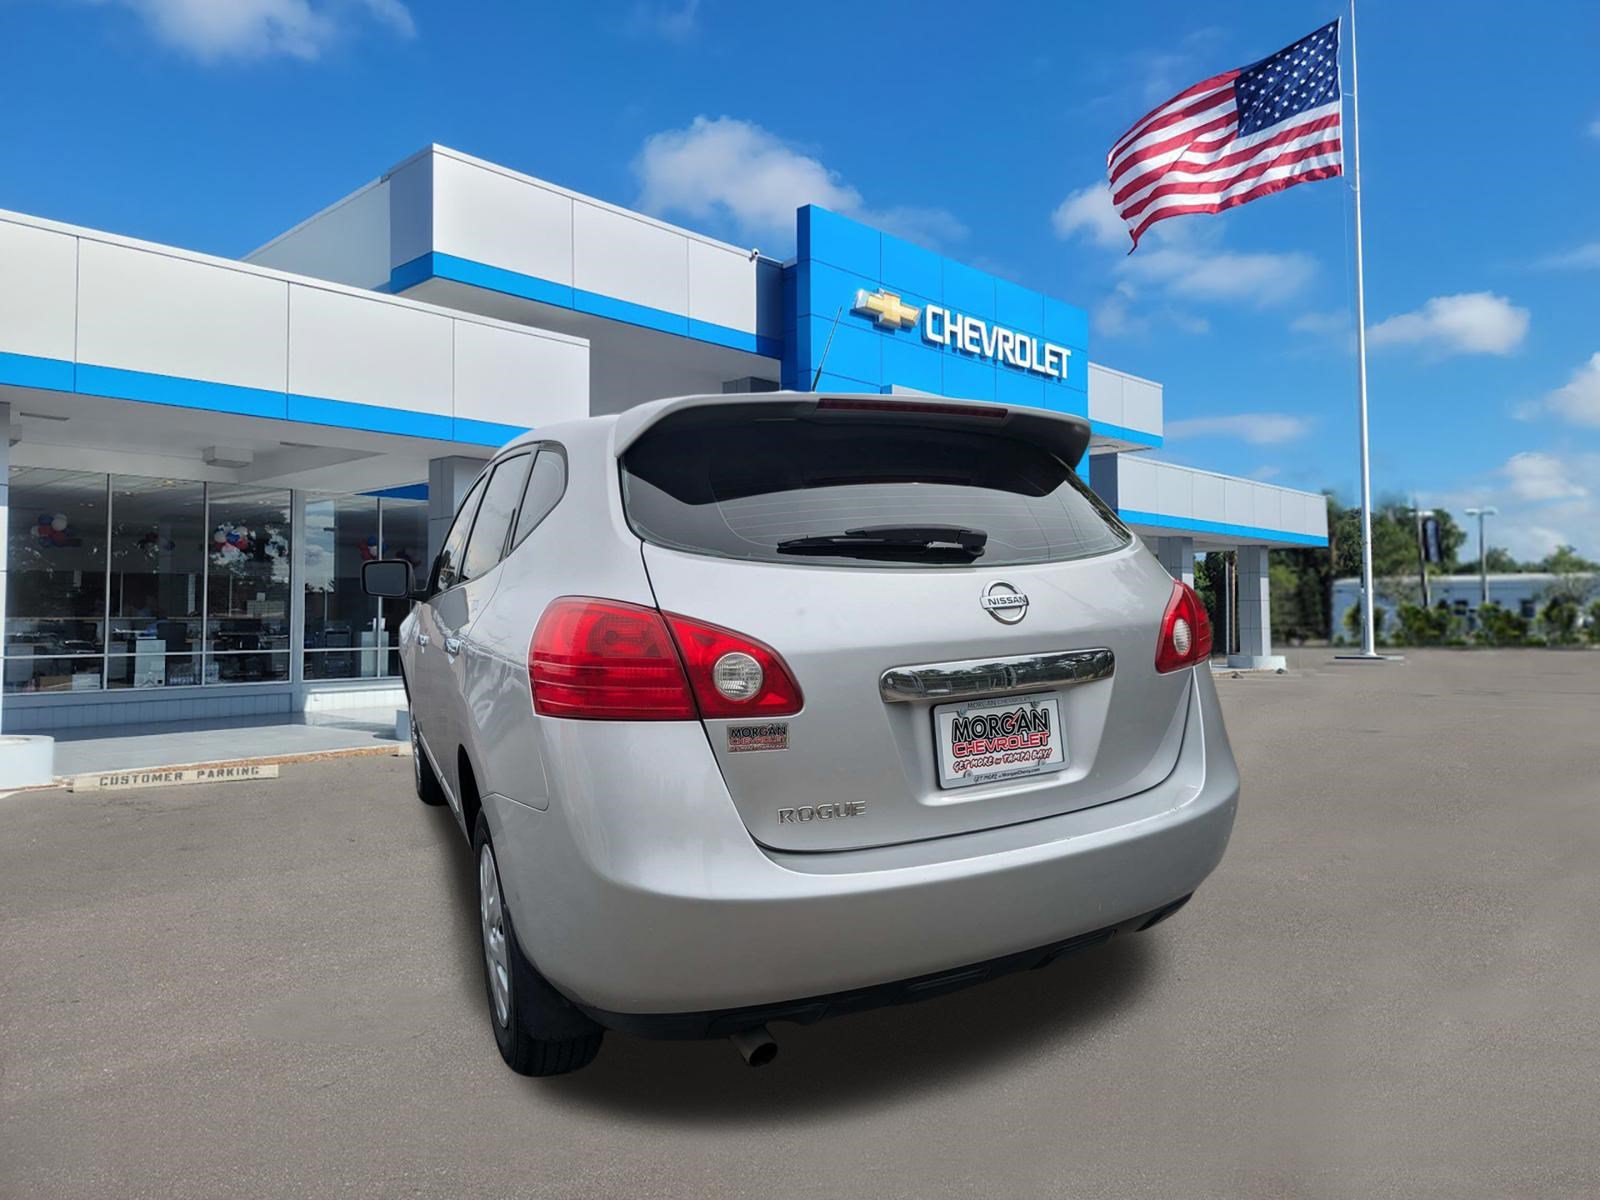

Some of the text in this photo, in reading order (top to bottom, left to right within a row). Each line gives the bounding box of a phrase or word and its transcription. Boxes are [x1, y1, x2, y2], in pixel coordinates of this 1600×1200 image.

[924, 303, 1072, 380] CHEVROLET
[988, 596, 1026, 605] NISSAN
[731, 723, 786, 737] MORGAN
[952, 708, 1050, 742] MORGAN
[952, 731, 1050, 758] CHEVROLET
[953, 760, 970, 773] GET
[971, 756, 993, 768] MORE
[1002, 750, 1031, 764] TAMPA
[99, 766, 260, 787] CUSTOMER PARKING
[777, 800, 867, 825] ROGUE
